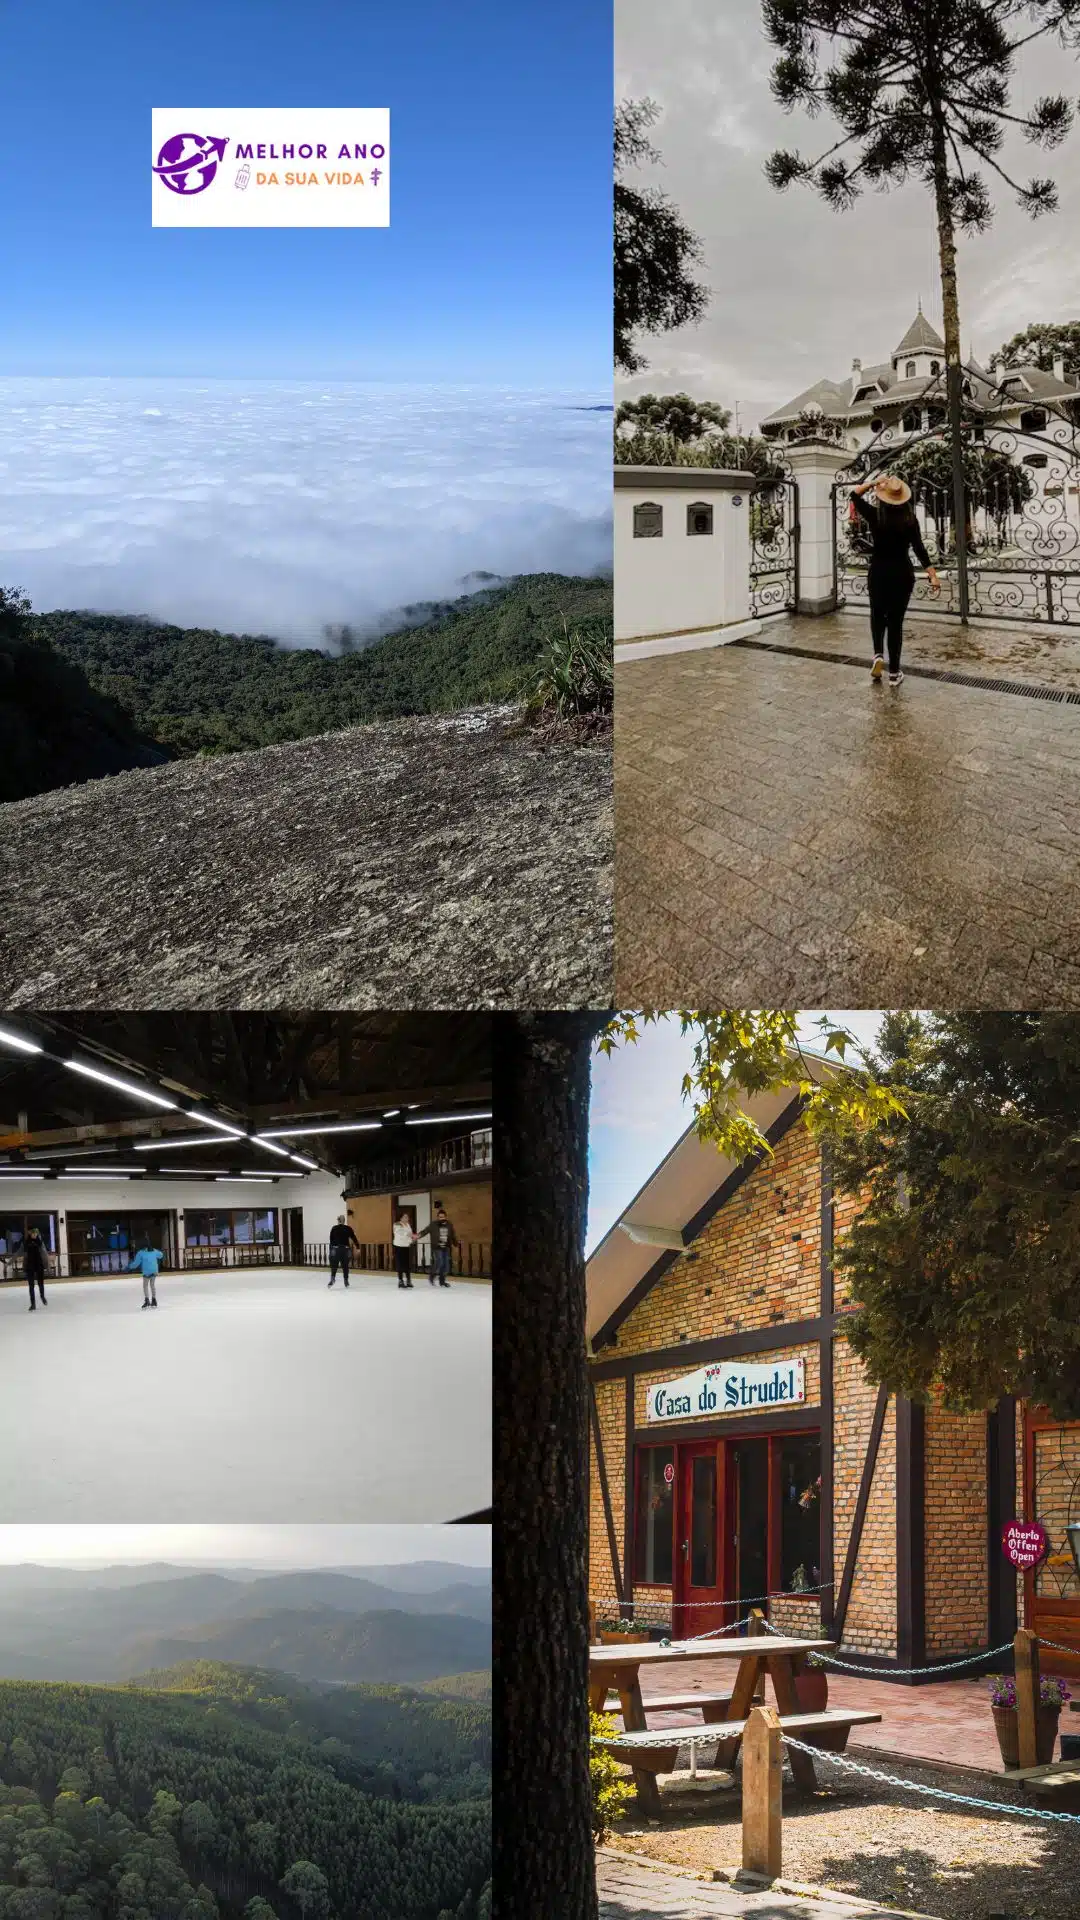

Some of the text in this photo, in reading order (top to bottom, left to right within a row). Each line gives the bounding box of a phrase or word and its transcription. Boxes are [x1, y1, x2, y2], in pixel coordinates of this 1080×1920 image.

[654, 1369, 795, 1417] Casa do Strudel
[1008, 1528, 1039, 1540] Aberto
[1008, 1539, 1037, 1551] Offen
[1010, 1549, 1034, 1563] Open
